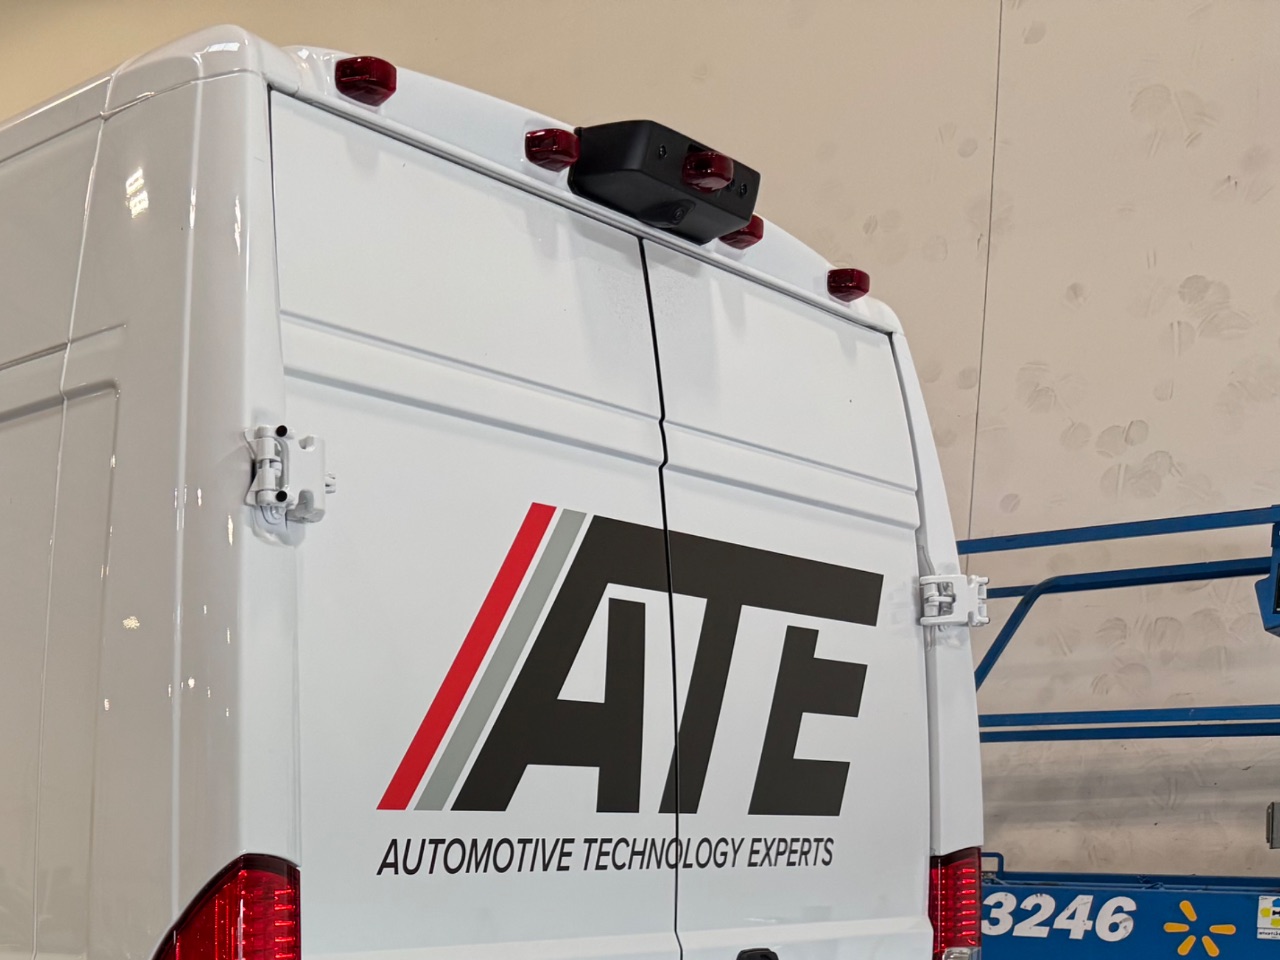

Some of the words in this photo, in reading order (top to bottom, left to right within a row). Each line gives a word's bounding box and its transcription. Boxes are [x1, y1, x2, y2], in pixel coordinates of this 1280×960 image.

[450, 514, 884, 816] ATE
[376, 838, 575, 876] AUTOMOTIVE
[582, 838, 744, 871] TECHNOLOGY
[746, 837, 835, 867] EXPERTS
[981, 892, 1137, 942] 3246
